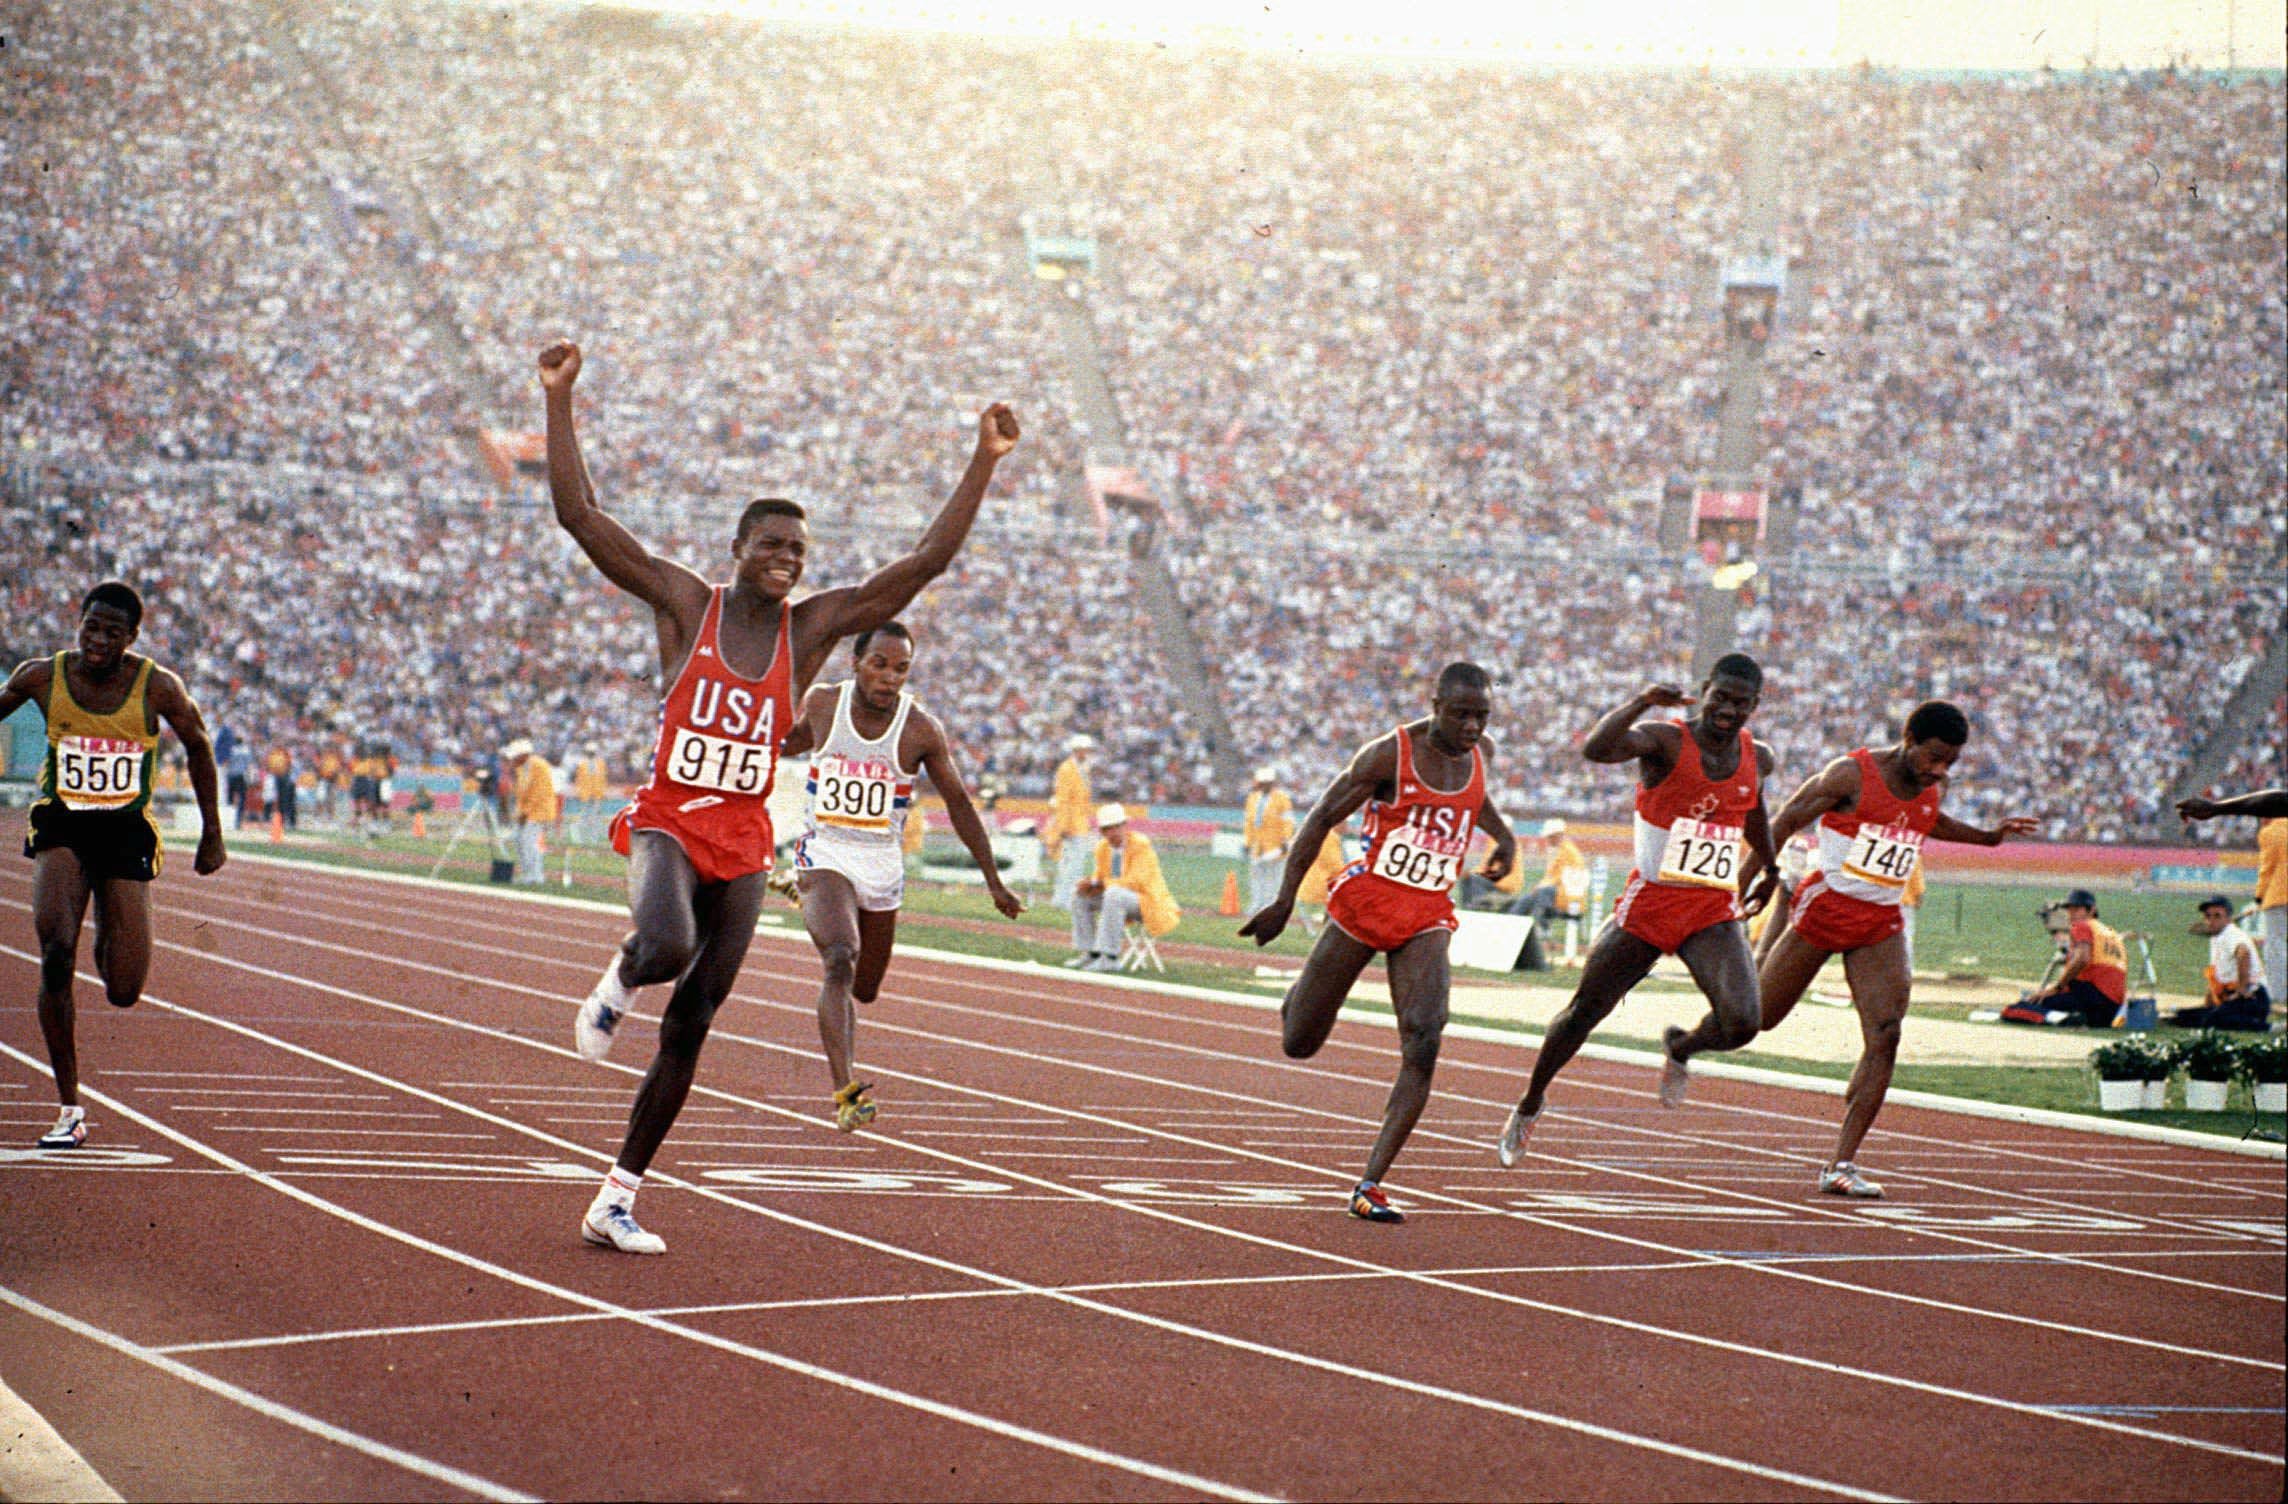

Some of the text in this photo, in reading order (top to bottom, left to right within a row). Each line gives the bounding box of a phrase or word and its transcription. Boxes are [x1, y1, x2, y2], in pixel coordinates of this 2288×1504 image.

[690, 677, 775, 744] USA
[65, 753, 133, 792] 550
[677, 736, 762, 791] 915
[823, 777, 887, 817] 390
[1407, 803, 1472, 841] USA
[1384, 844, 1450, 887] 901
[1678, 838, 1733, 879] 126
[1861, 838, 1914, 878] 140
